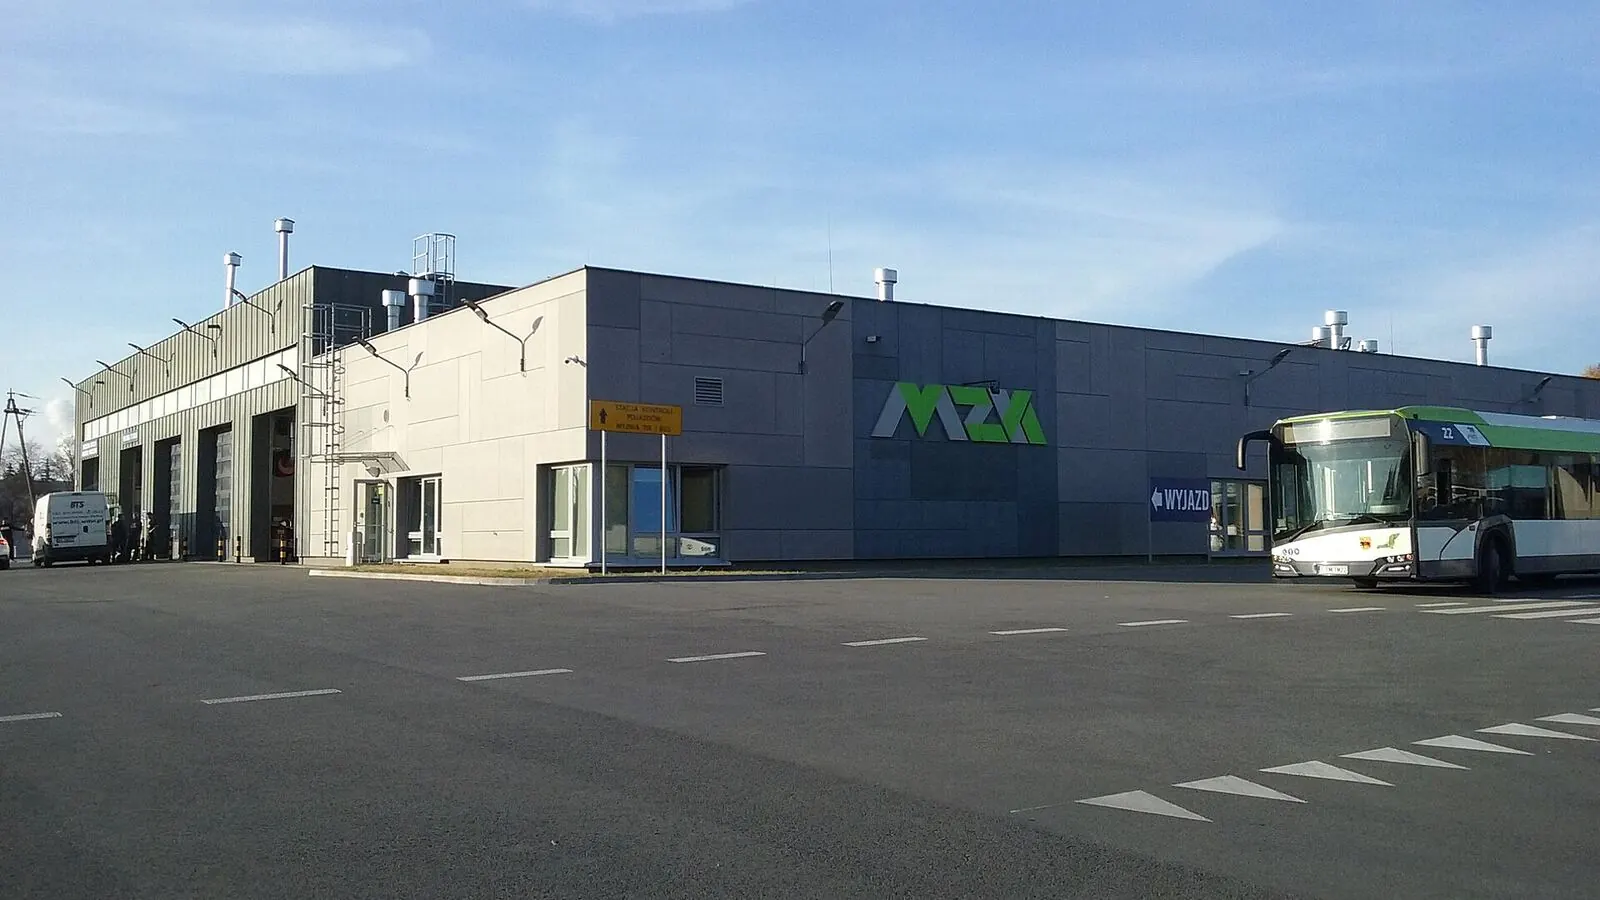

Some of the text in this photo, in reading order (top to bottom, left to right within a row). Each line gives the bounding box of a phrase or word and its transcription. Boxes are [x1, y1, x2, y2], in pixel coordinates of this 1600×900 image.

[871, 382, 1048, 445] MZK
[1441, 427, 1454, 439] 22
[70, 501, 85, 509] BTS
[1164, 488, 1210, 511] WYJAZD
